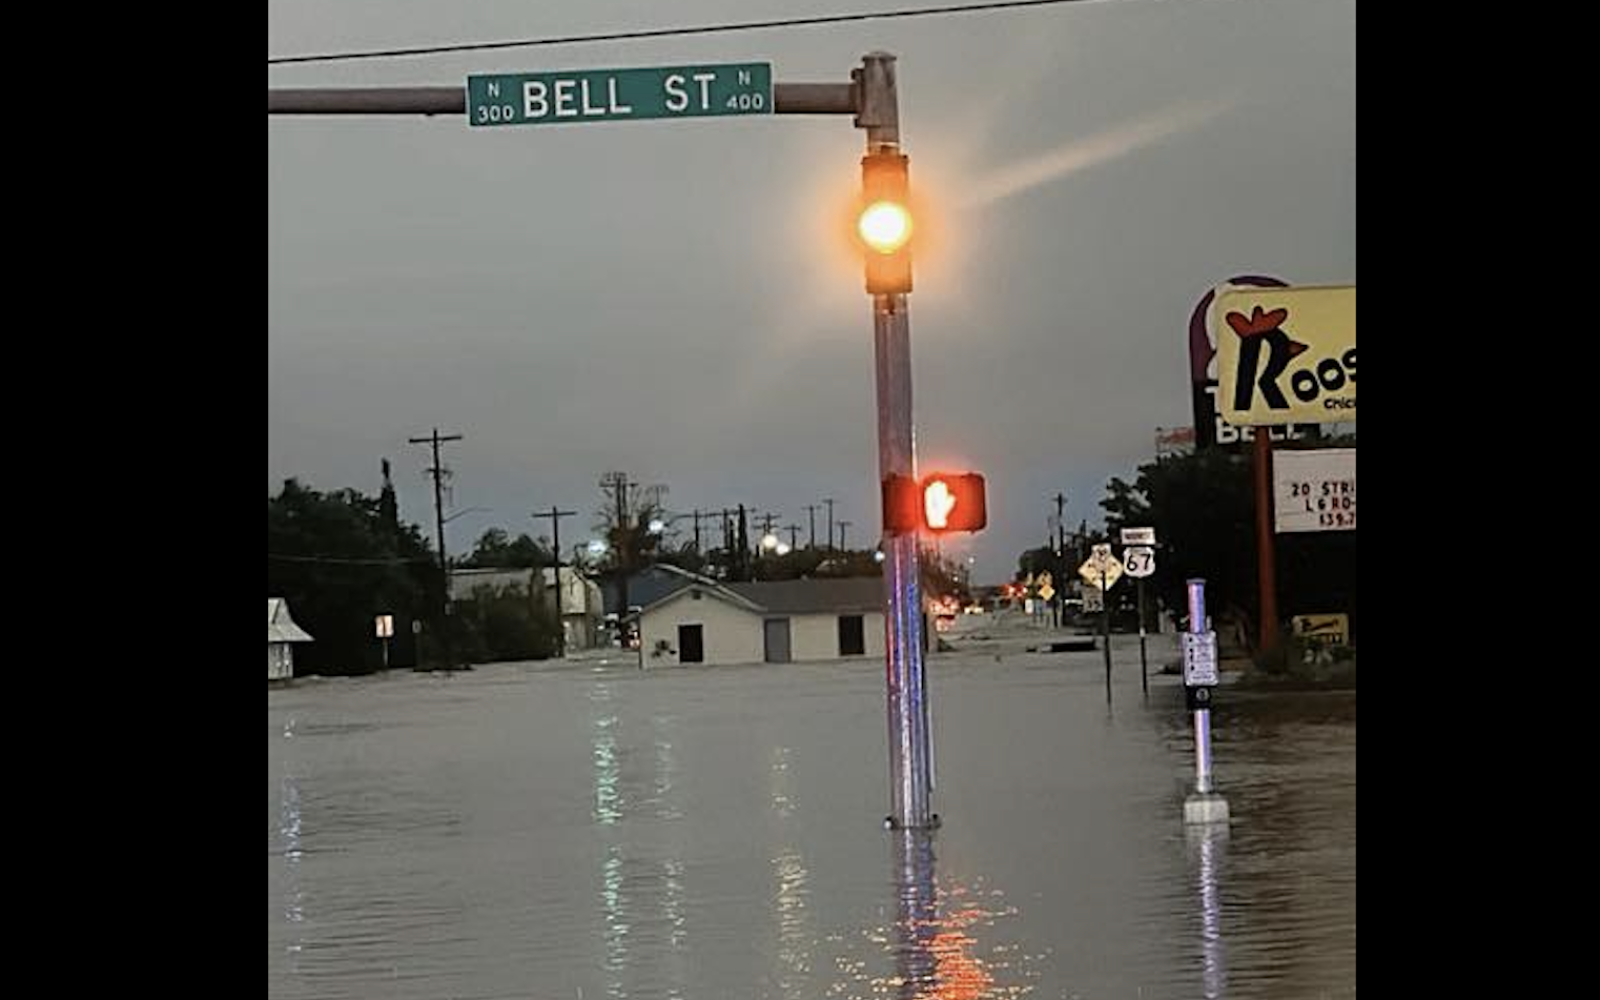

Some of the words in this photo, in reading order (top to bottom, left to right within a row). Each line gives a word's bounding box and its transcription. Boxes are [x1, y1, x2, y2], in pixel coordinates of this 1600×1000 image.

[738, 71, 750, 85] N
[488, 83, 499, 98] N
[522, 77, 632, 118] BELL
[664, 74, 716, 111] ST
[726, 94, 763, 110] 400
[478, 105, 514, 123] 300
[1127, 553, 1151, 571] 67
